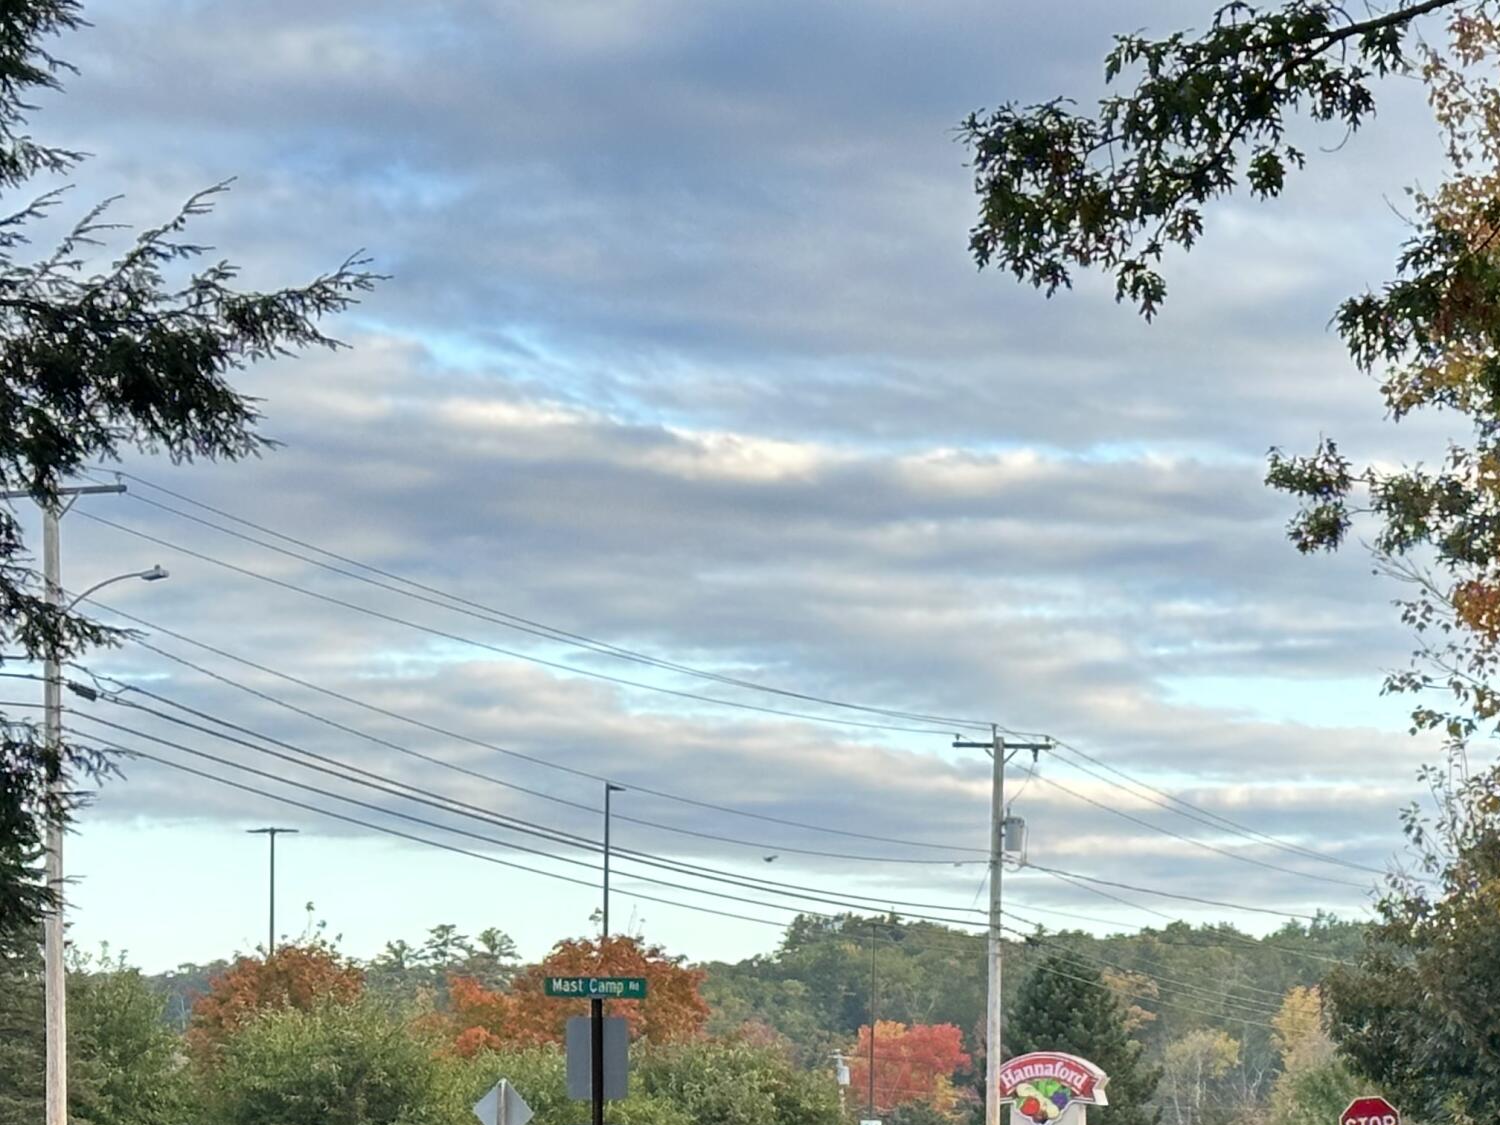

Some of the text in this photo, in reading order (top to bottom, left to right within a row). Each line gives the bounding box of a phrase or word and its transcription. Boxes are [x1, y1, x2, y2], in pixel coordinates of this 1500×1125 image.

[552, 978, 640, 996] Mast Camp Rd
[1001, 1061, 1088, 1089] Hannaford
